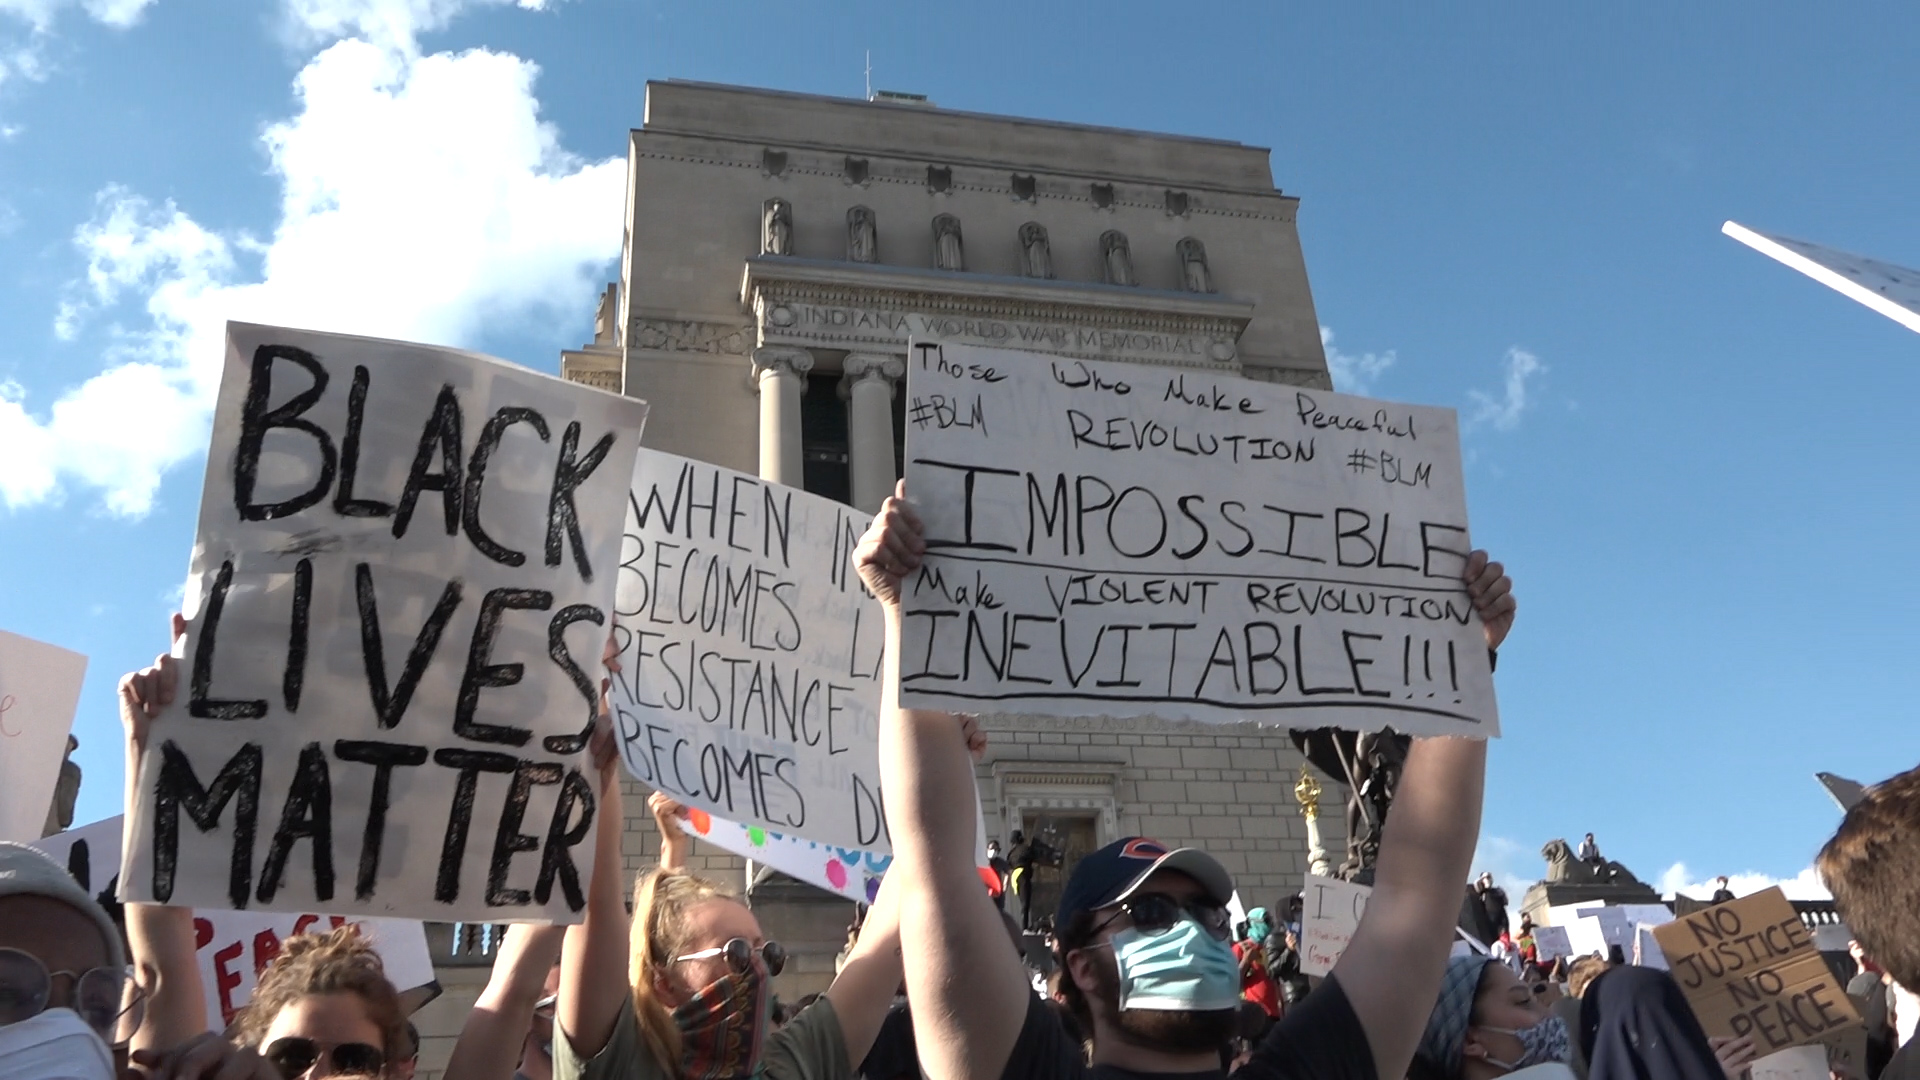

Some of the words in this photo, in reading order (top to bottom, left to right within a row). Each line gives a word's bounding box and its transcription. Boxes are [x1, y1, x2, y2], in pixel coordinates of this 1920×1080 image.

[804, 307, 911, 332] INDIANA
[920, 316, 1008, 341] WORLD
[1017, 324, 1069, 345] WAR
[1077, 328, 1202, 355] MEMORIAL
[909, 394, 989, 438] #BLM
[914, 342, 1009, 383] Those
[1051, 361, 1132, 395] Who
[1165, 374, 1265, 413] Make
[1296, 392, 1417, 441] Peaceful
[1067, 409, 1315, 464] REVOLUTION
[233, 343, 618, 585] BLACK
[1346, 448, 1433, 489] #BLM
[629, 461, 792, 569] WHEN
[912, 459, 1468, 578] IMPOSSIBLE
[614, 533, 801, 652] BECOMES
[914, 564, 1005, 609] Make
[1045, 573, 1220, 616] VIOLENT
[1248, 583, 1474, 626] REVOLUTION
[188, 552, 606, 755] LIVES
[605, 624, 855, 755] RESISTANCE
[902, 609, 1463, 704] INEVITABLE!!!
[616, 703, 806, 829] BECOMES
[151, 738, 597, 913] MATTER
[1675, 916, 1811, 990] JUSTICE
[1685, 906, 1742, 947] NO
[1725, 969, 1784, 1008] NO
[1729, 982, 1850, 1050] PEACE
